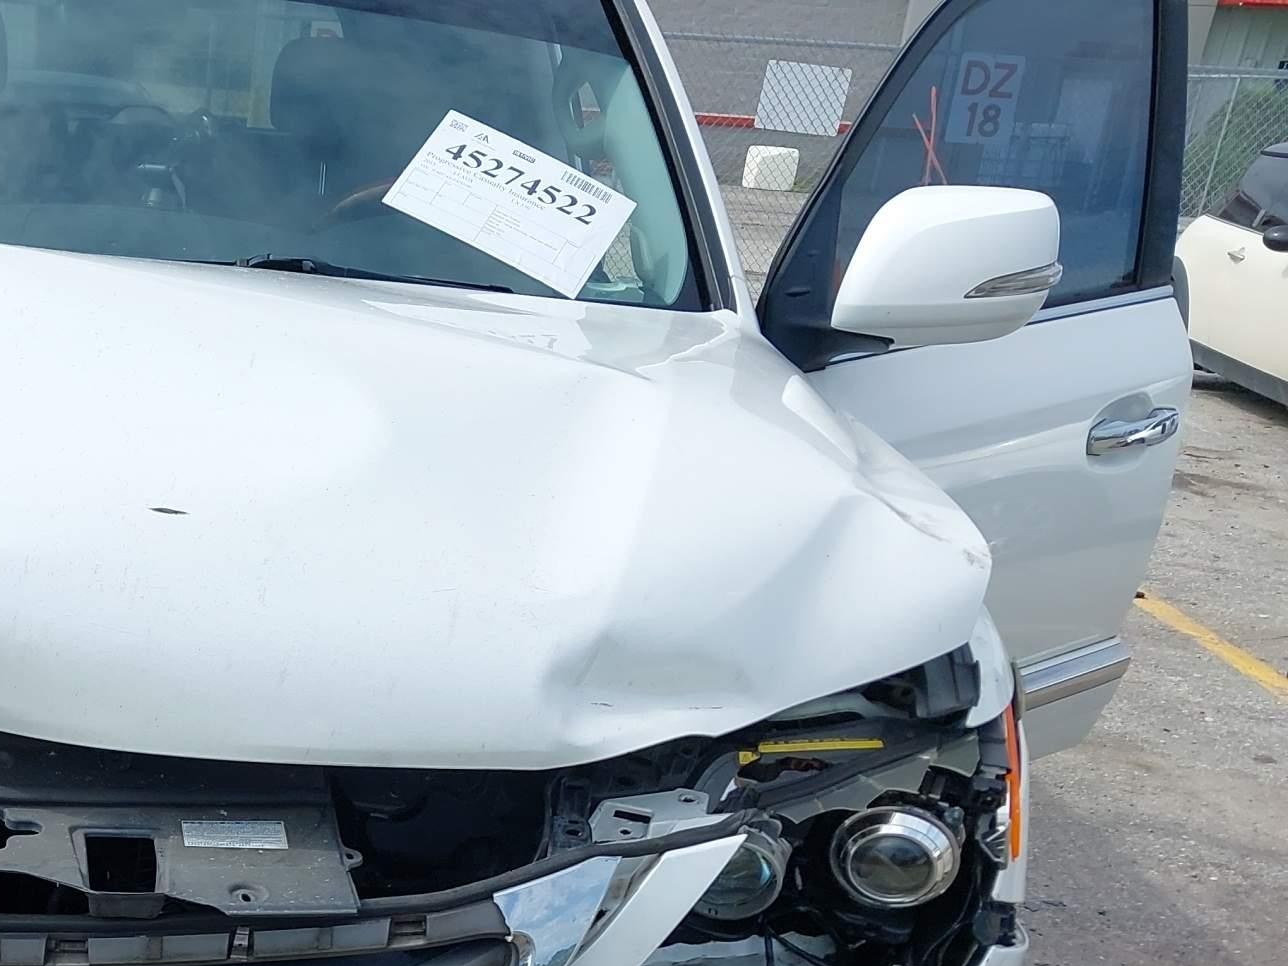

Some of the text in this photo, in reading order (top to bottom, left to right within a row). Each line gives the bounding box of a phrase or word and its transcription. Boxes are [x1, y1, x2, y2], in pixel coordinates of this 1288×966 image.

[960, 60, 1018, 99] DZ
[966, 102, 1001, 137] 18
[445, 144, 597, 225] 45274522
